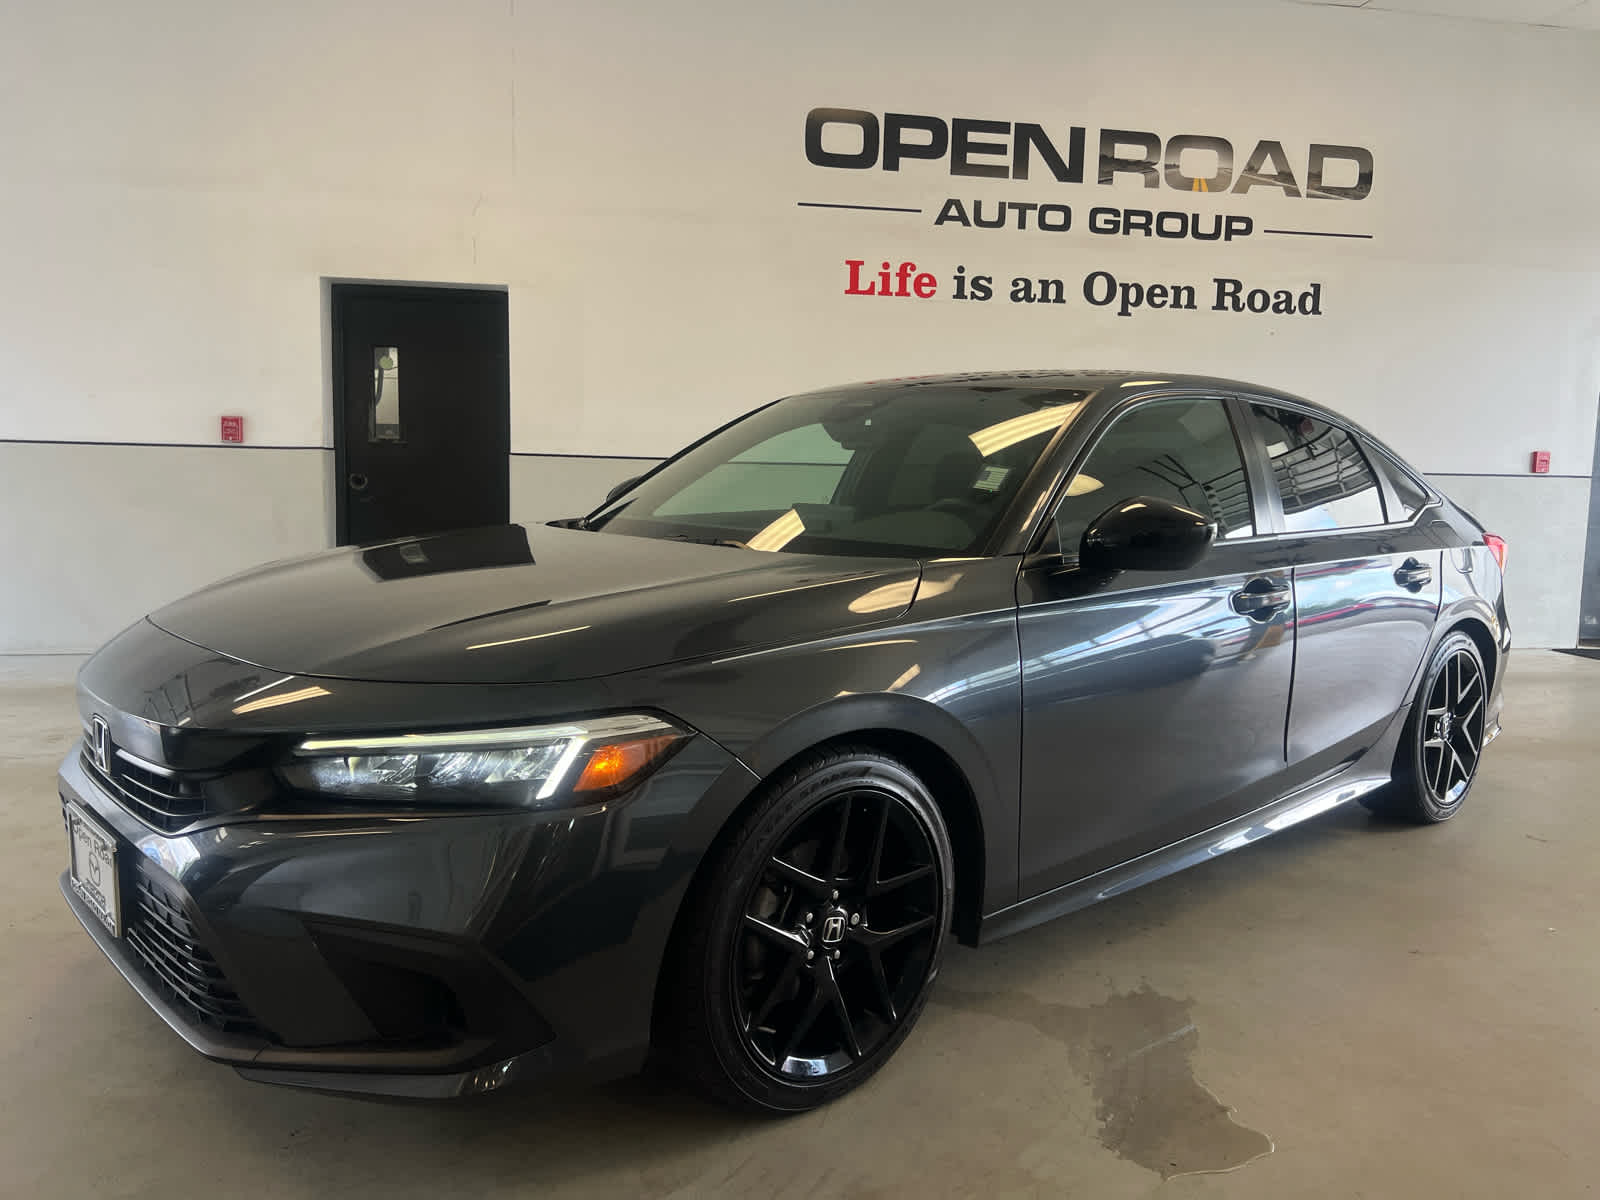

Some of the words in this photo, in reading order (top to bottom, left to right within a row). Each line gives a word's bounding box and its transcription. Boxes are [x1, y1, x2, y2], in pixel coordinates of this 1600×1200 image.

[805, 107, 1086, 184] OPEN
[1098, 128, 1374, 201] ROAD
[933, 198, 1073, 233] AUTO
[1088, 206, 1254, 242] GROUP
[844, 259, 938, 298] Life
[952, 265, 993, 301] is
[1009, 277, 1067, 305] an
[1082, 270, 1198, 317] Open
[1211, 278, 1323, 316] Road
